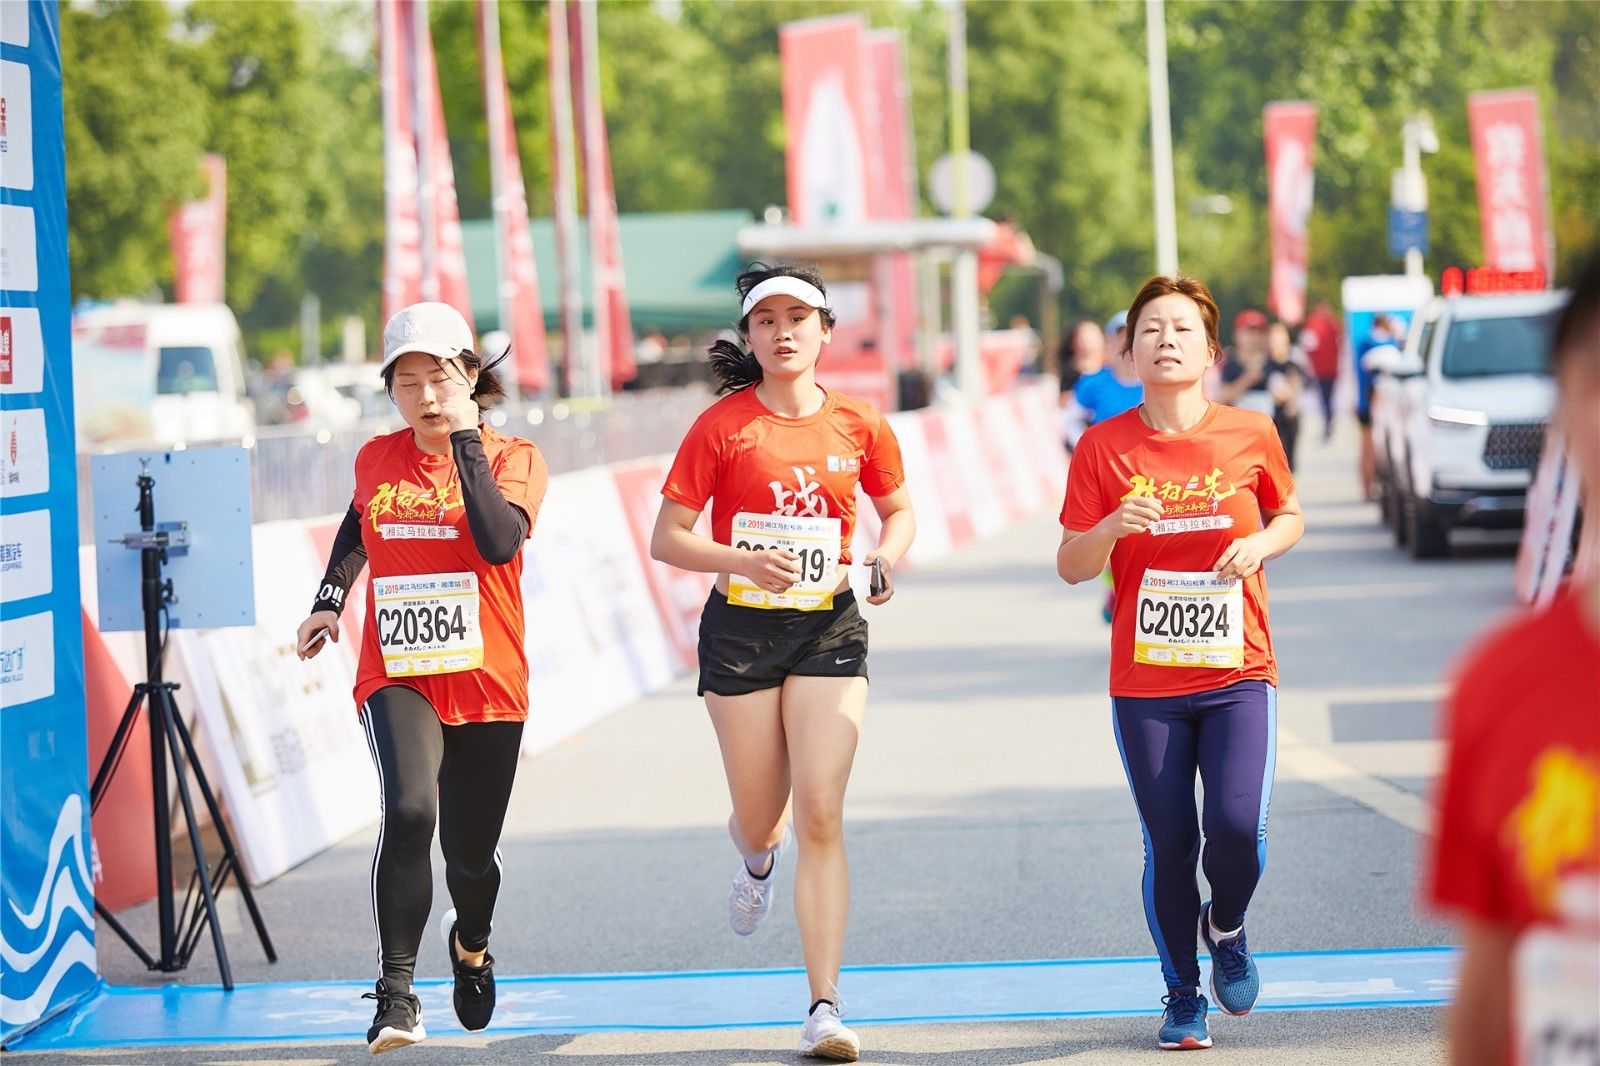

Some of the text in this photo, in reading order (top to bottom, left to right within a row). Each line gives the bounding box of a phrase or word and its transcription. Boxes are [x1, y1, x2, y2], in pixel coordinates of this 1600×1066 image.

[385, 526, 449, 538] 湘江马拉松赛
[1155, 518, 1222, 533] 湘江马拉松赛
[378, 604, 467, 647] C20364
[1140, 598, 1230, 638] C20324
